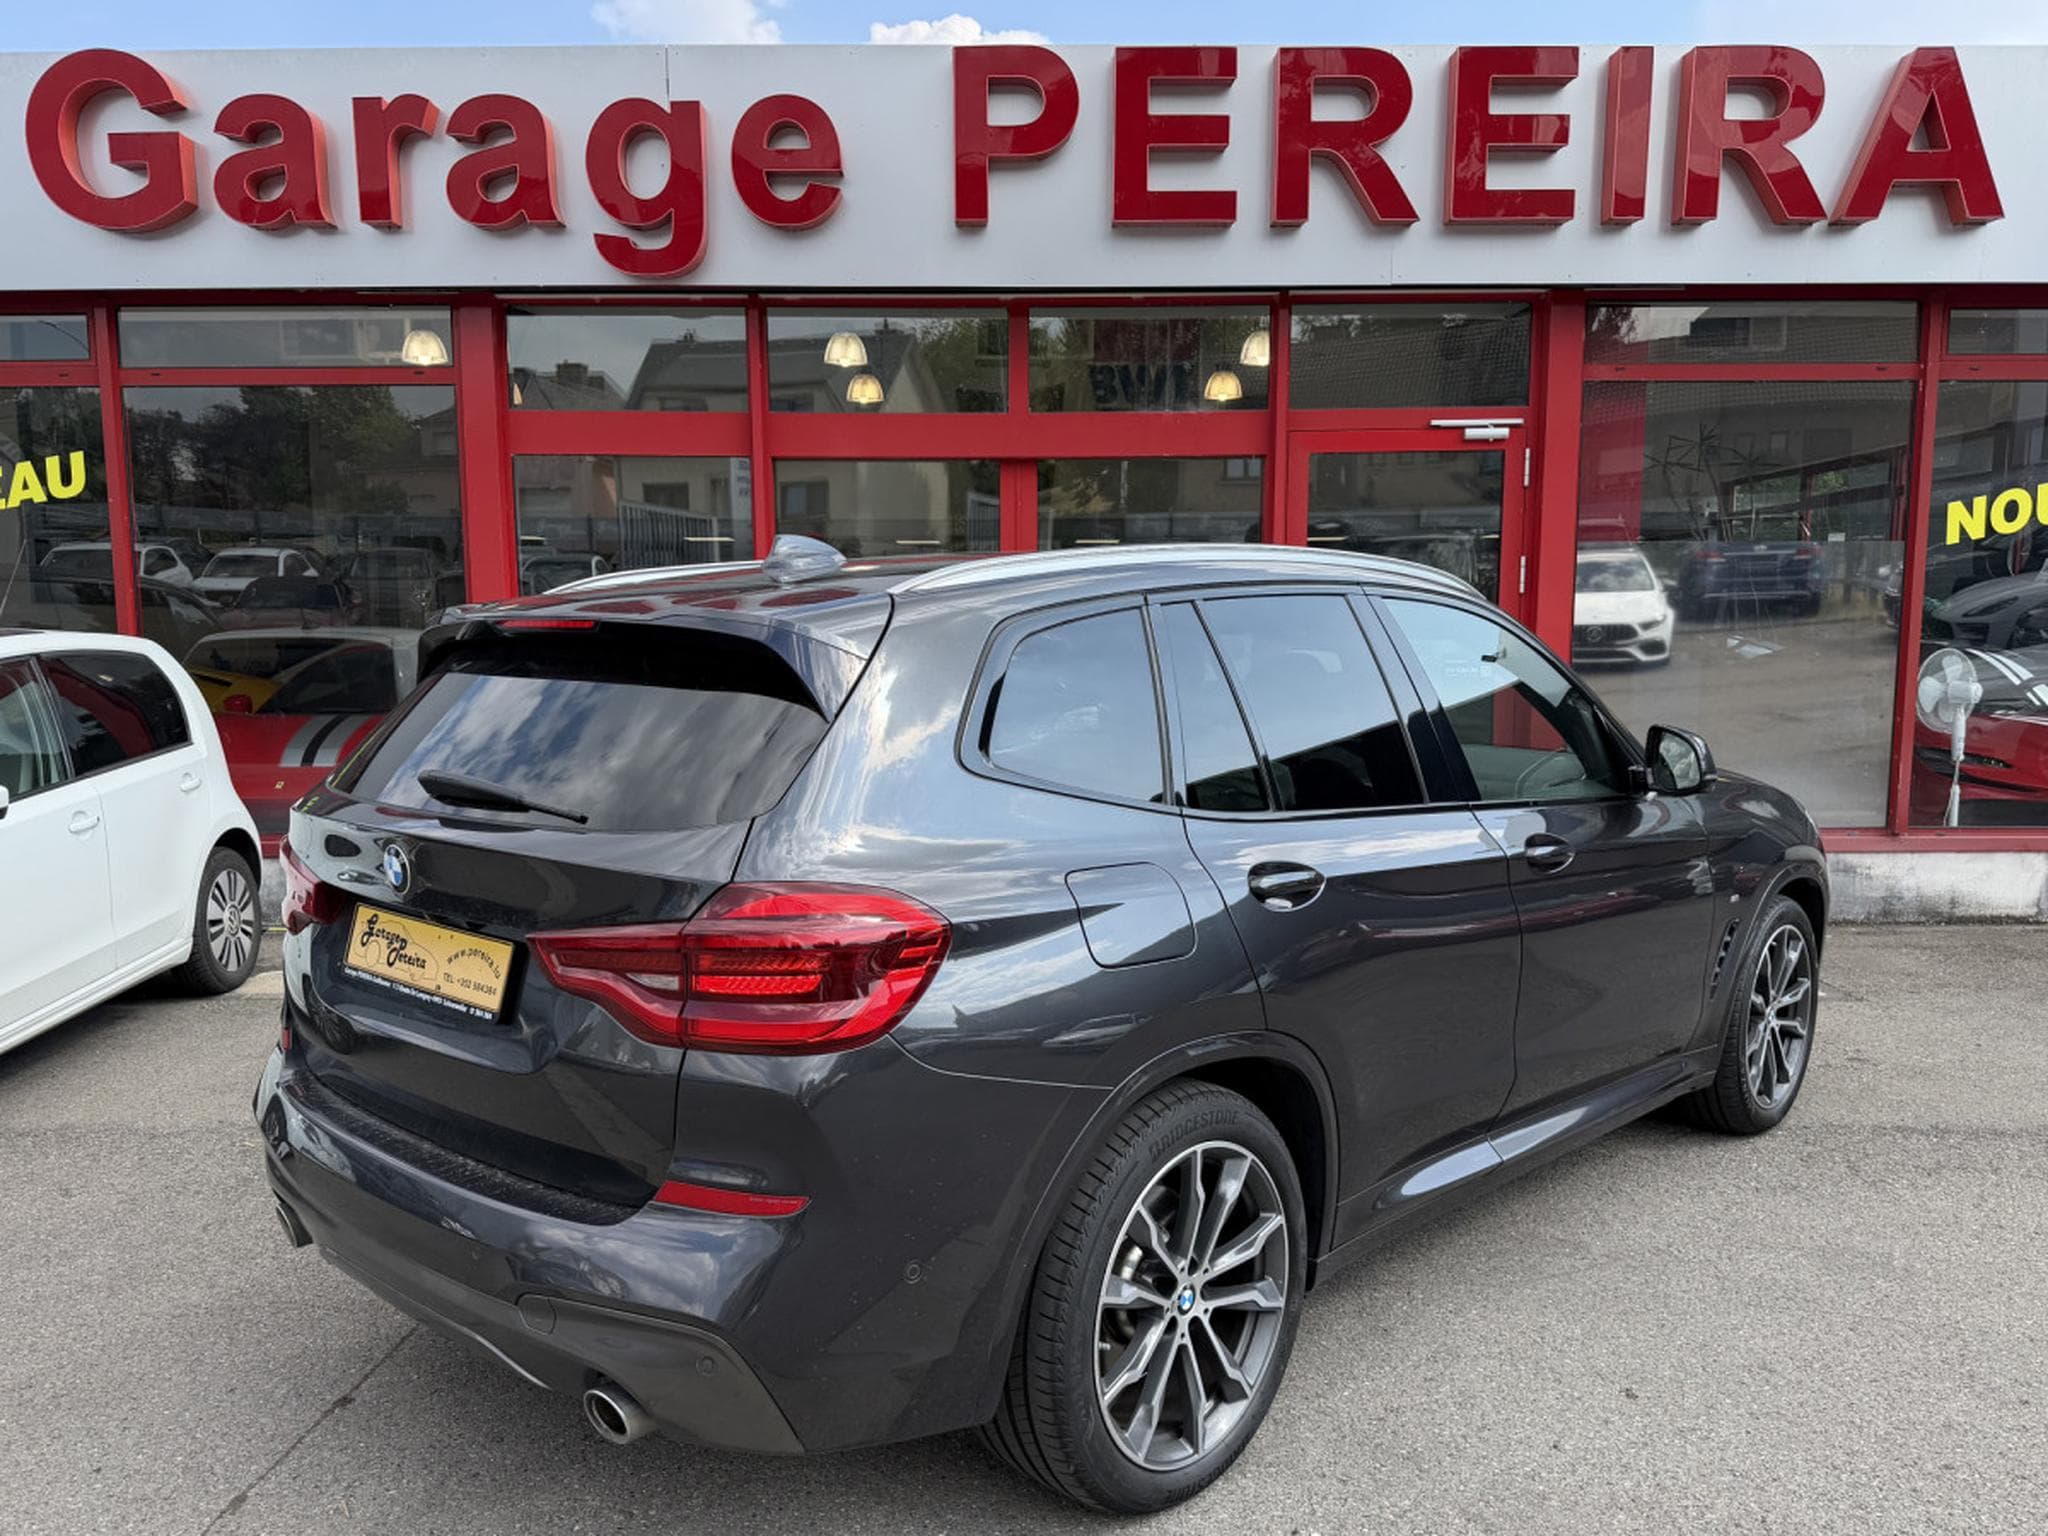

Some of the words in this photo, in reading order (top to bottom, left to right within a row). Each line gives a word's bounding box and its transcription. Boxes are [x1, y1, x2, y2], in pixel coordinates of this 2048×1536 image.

[25, 48, 844, 278] Garage
[953, 45, 2004, 227] PEREIRA
[0, 450, 86, 510] AU
[1945, 482, 2048, 545] NO
